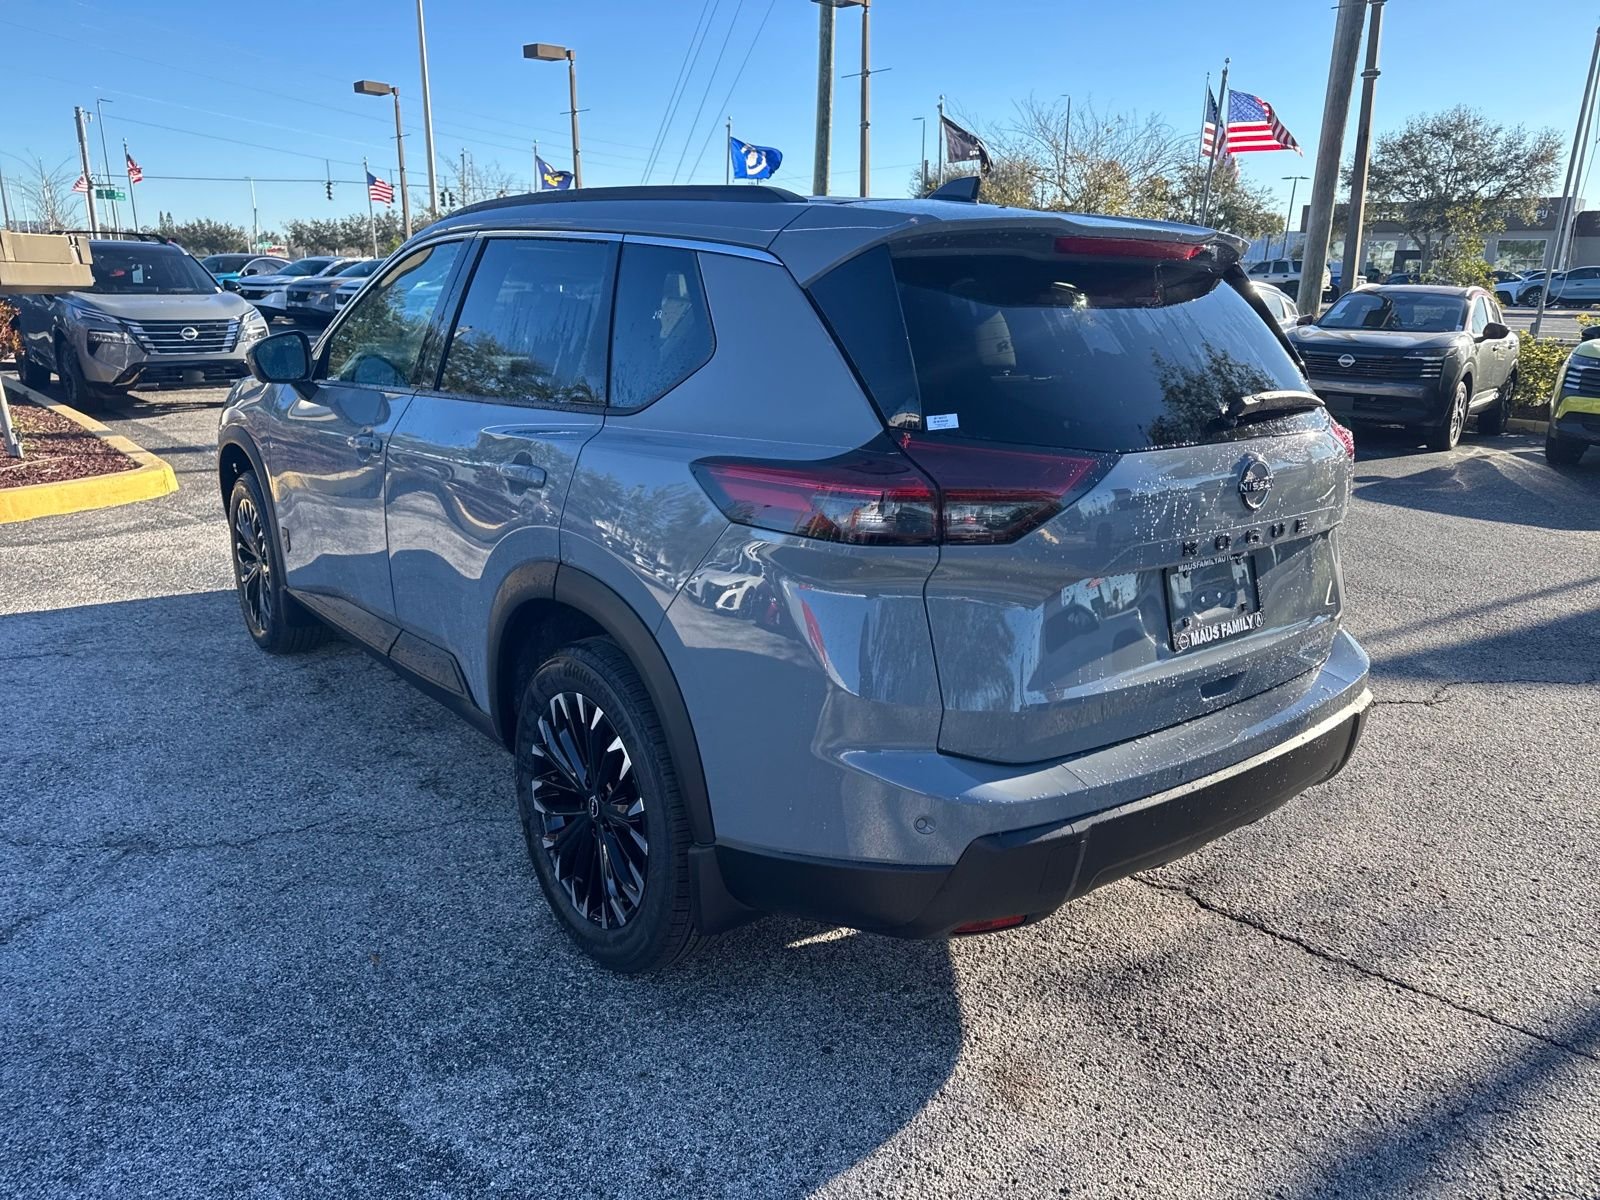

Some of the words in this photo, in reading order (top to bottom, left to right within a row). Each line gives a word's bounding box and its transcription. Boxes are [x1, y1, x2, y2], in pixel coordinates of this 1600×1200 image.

[1182, 517, 1307, 556] ROGUE
[1191, 624, 1220, 647] MAUS
[1221, 614, 1254, 638] FAMILY
